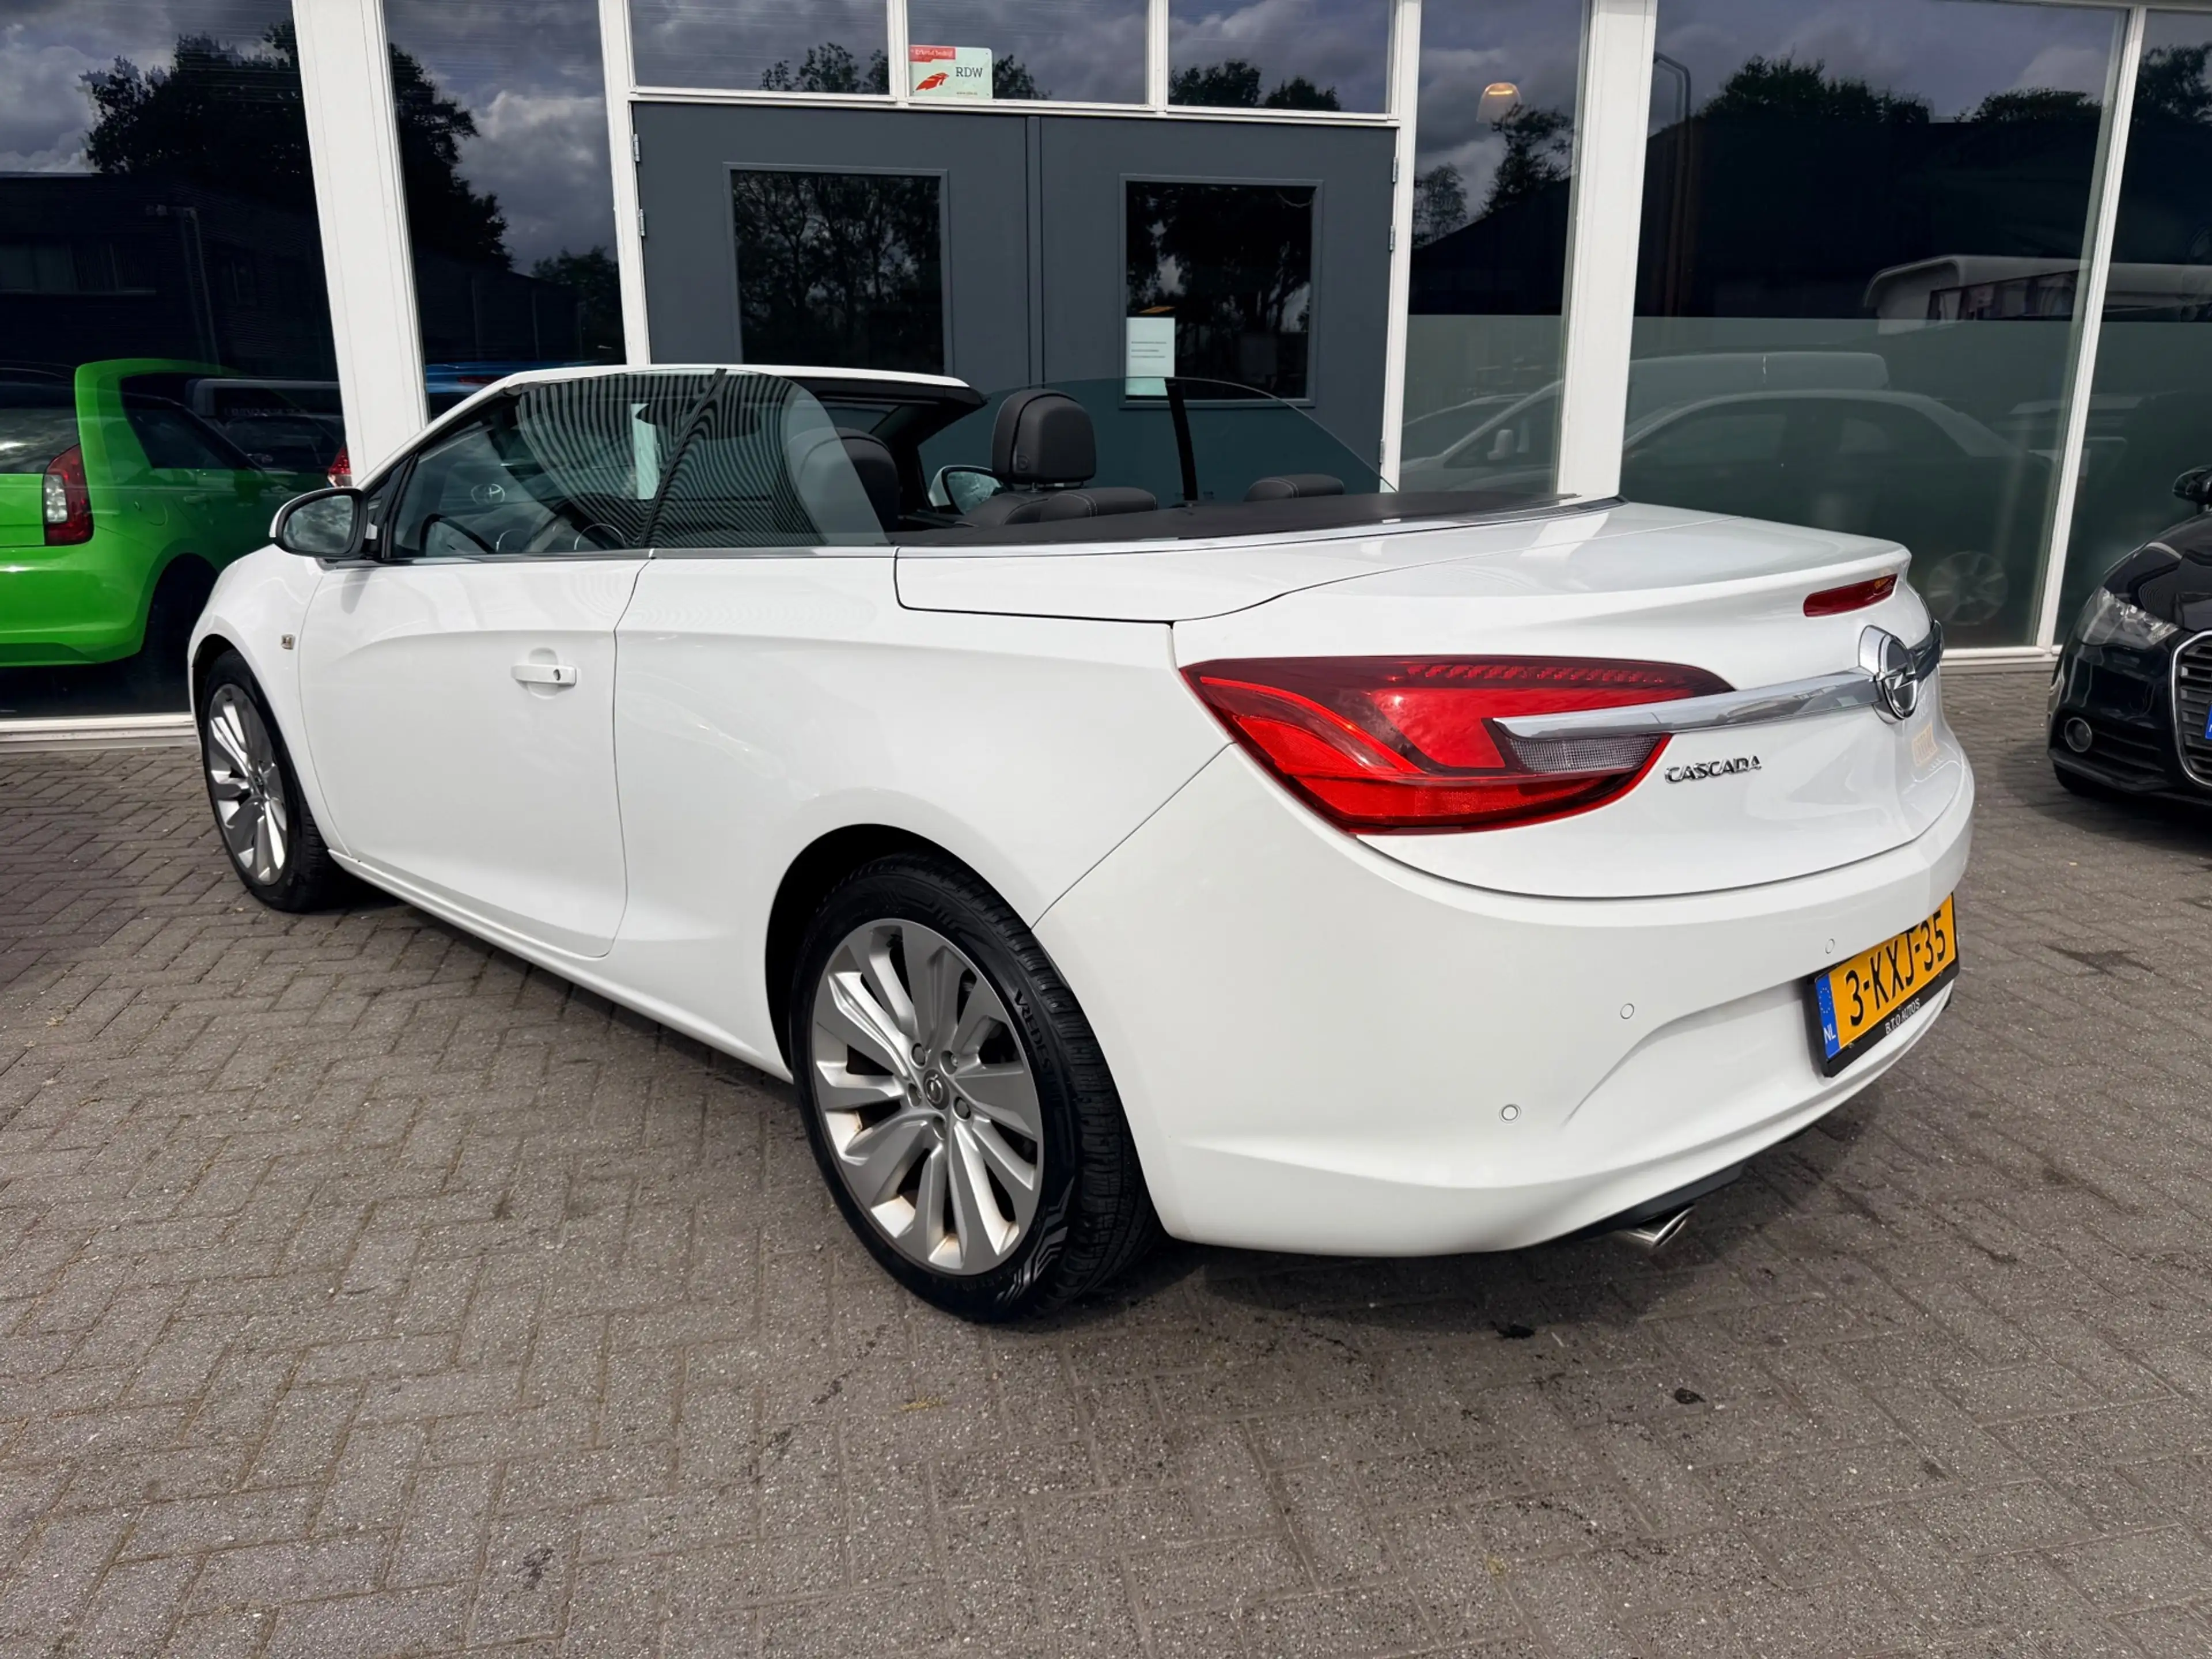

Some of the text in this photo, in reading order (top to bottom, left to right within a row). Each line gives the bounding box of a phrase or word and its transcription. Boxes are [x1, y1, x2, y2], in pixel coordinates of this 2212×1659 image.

[955, 66, 983, 78] RDW
[1664, 754, 1762, 784] CASCADA
[1845, 909, 1946, 1027] 3-KXJ-35
[1823, 1023, 1836, 1044] NL
